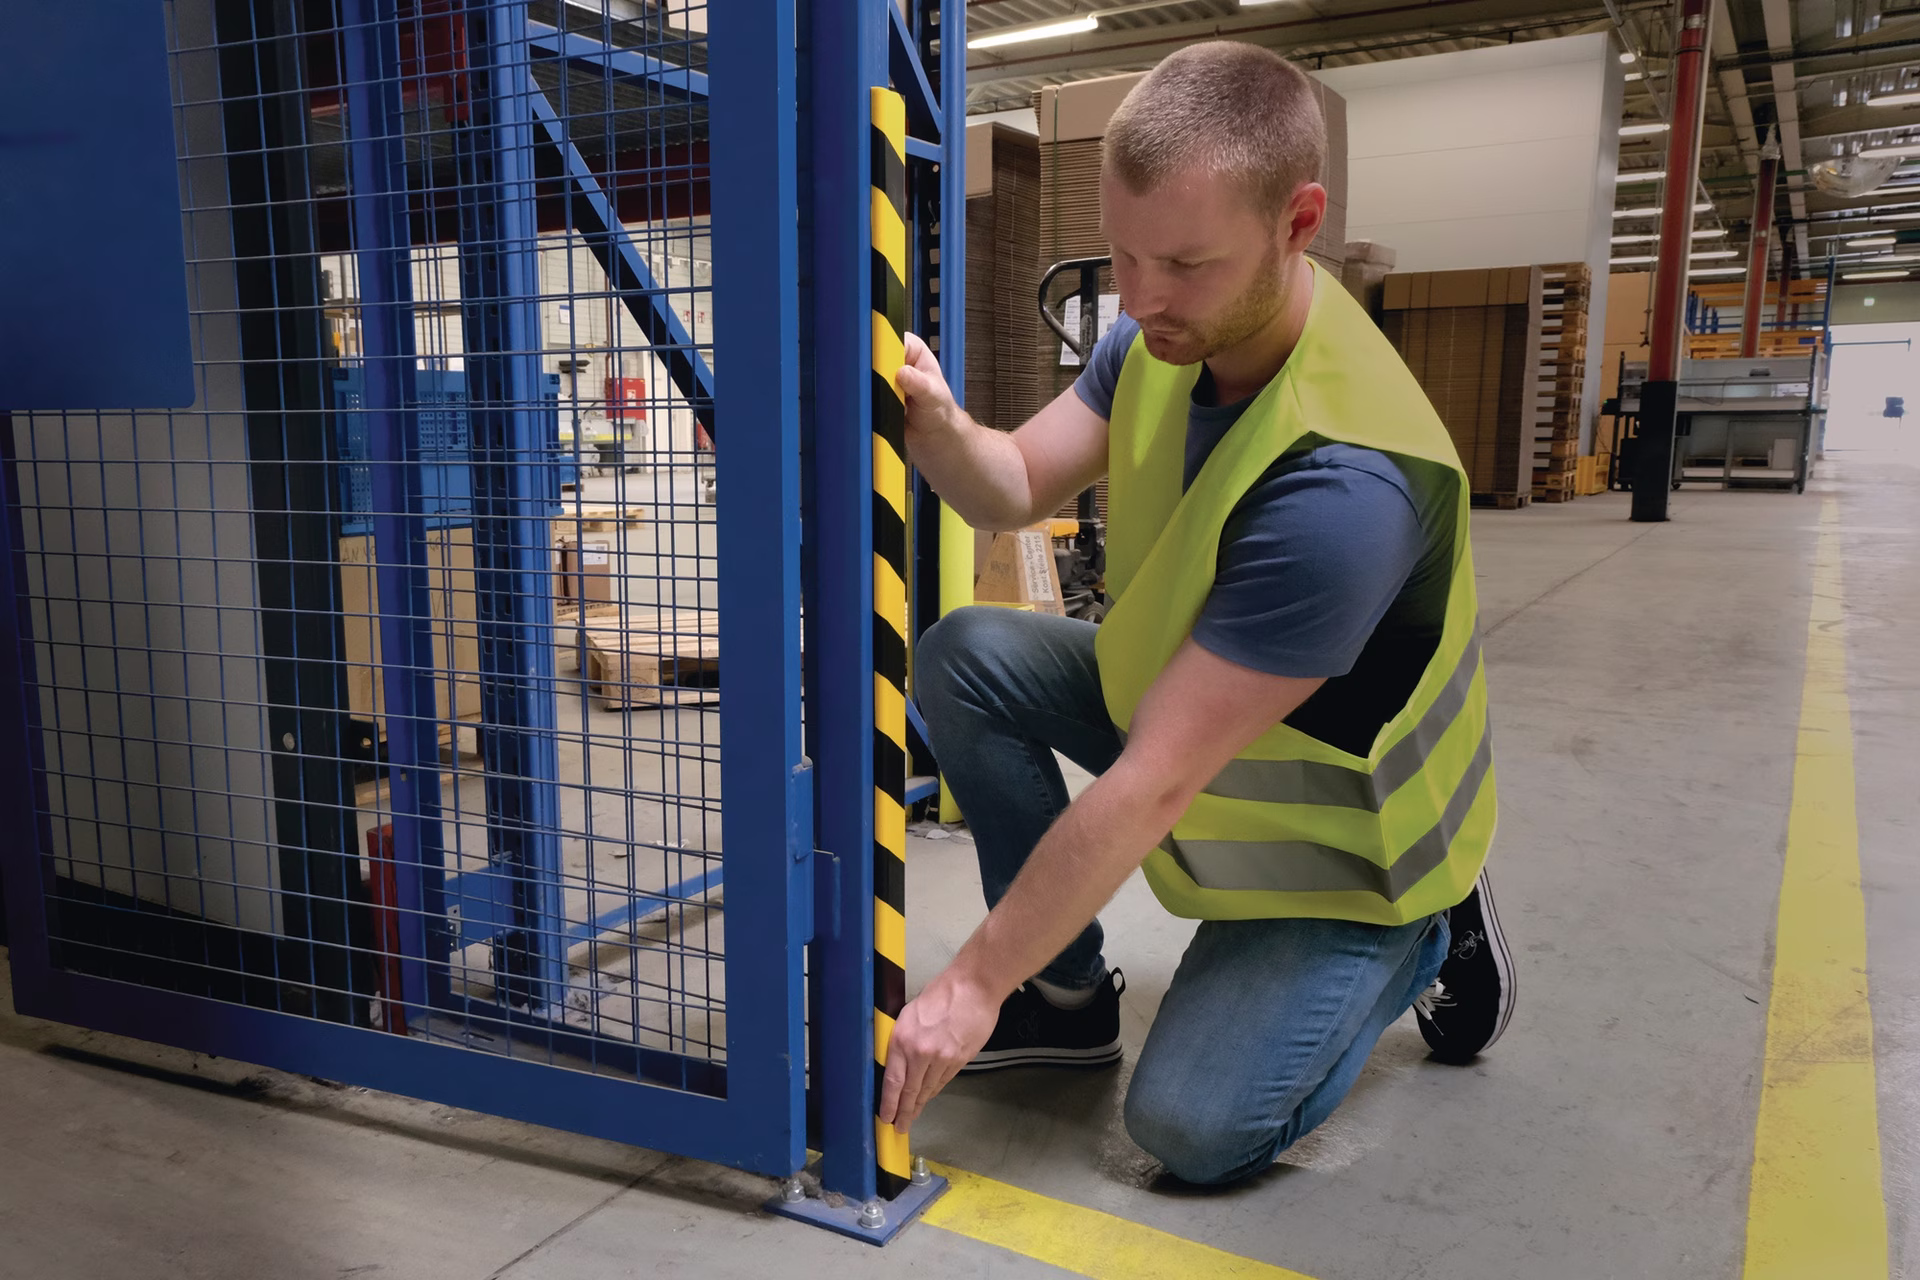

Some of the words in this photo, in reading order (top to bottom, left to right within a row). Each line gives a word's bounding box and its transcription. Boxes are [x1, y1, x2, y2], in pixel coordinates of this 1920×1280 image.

[1025, 535, 1034, 560] Center
[1034, 535, 1042, 552] 2215
[1030, 566, 1039, 593] Service
